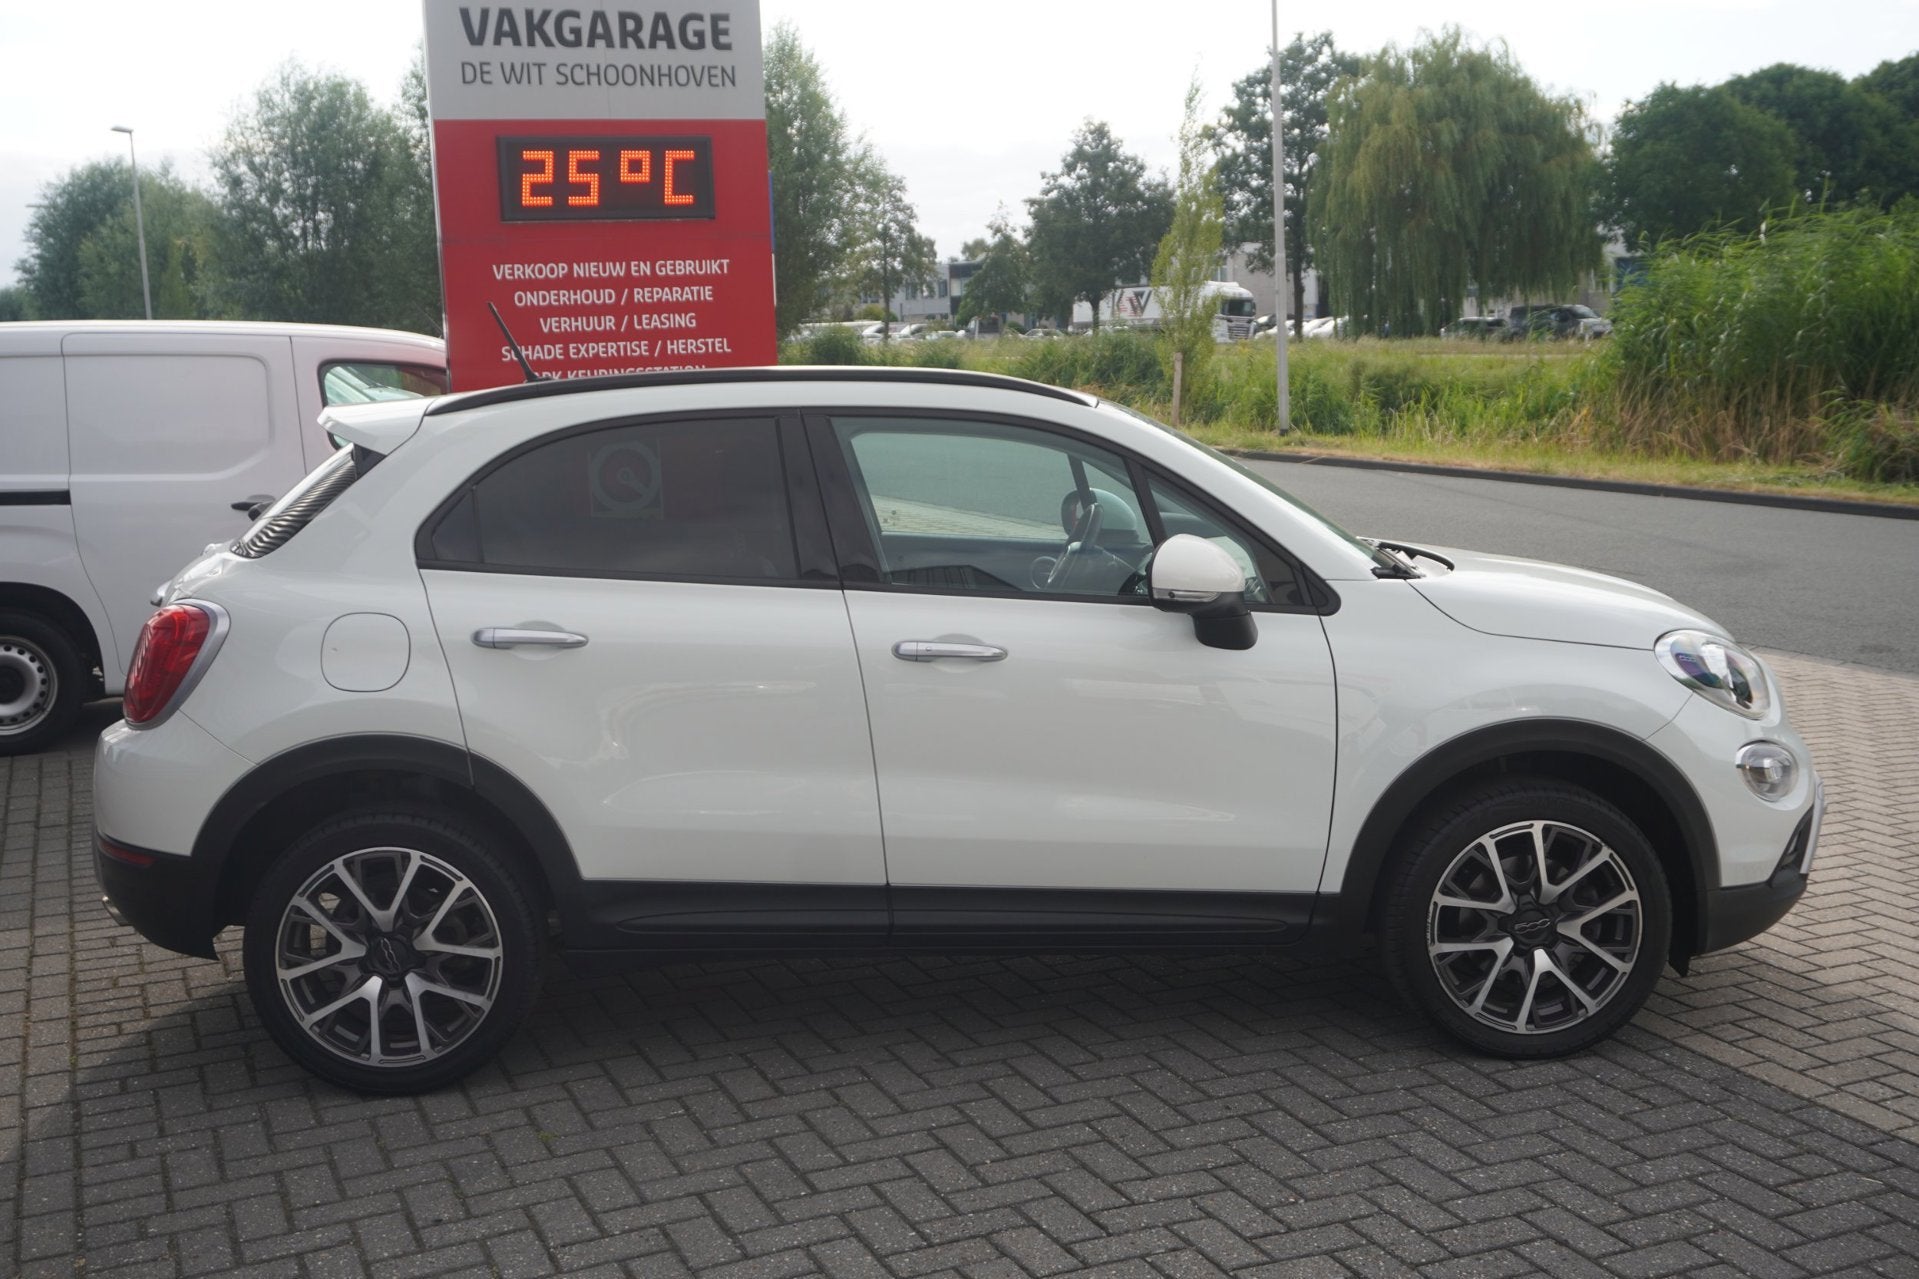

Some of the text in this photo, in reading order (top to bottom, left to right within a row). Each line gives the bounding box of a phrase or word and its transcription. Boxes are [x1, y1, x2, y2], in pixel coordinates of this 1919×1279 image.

[459, 7, 733, 51] VAKGARAGE
[461, 61, 737, 88] DE WIT SCHOONHOVEN
[492, 259, 730, 280] VERKOOP NIEUW EN GEBRUIKT
[514, 286, 714, 307] ONDERHOUD / REPARATIE
[540, 313, 697, 333] VERHUUR / LEASING
[569, 341, 649, 359] EXPERTISE
[654, 340, 662, 357] /
[667, 338, 732, 355] HERSTEL
